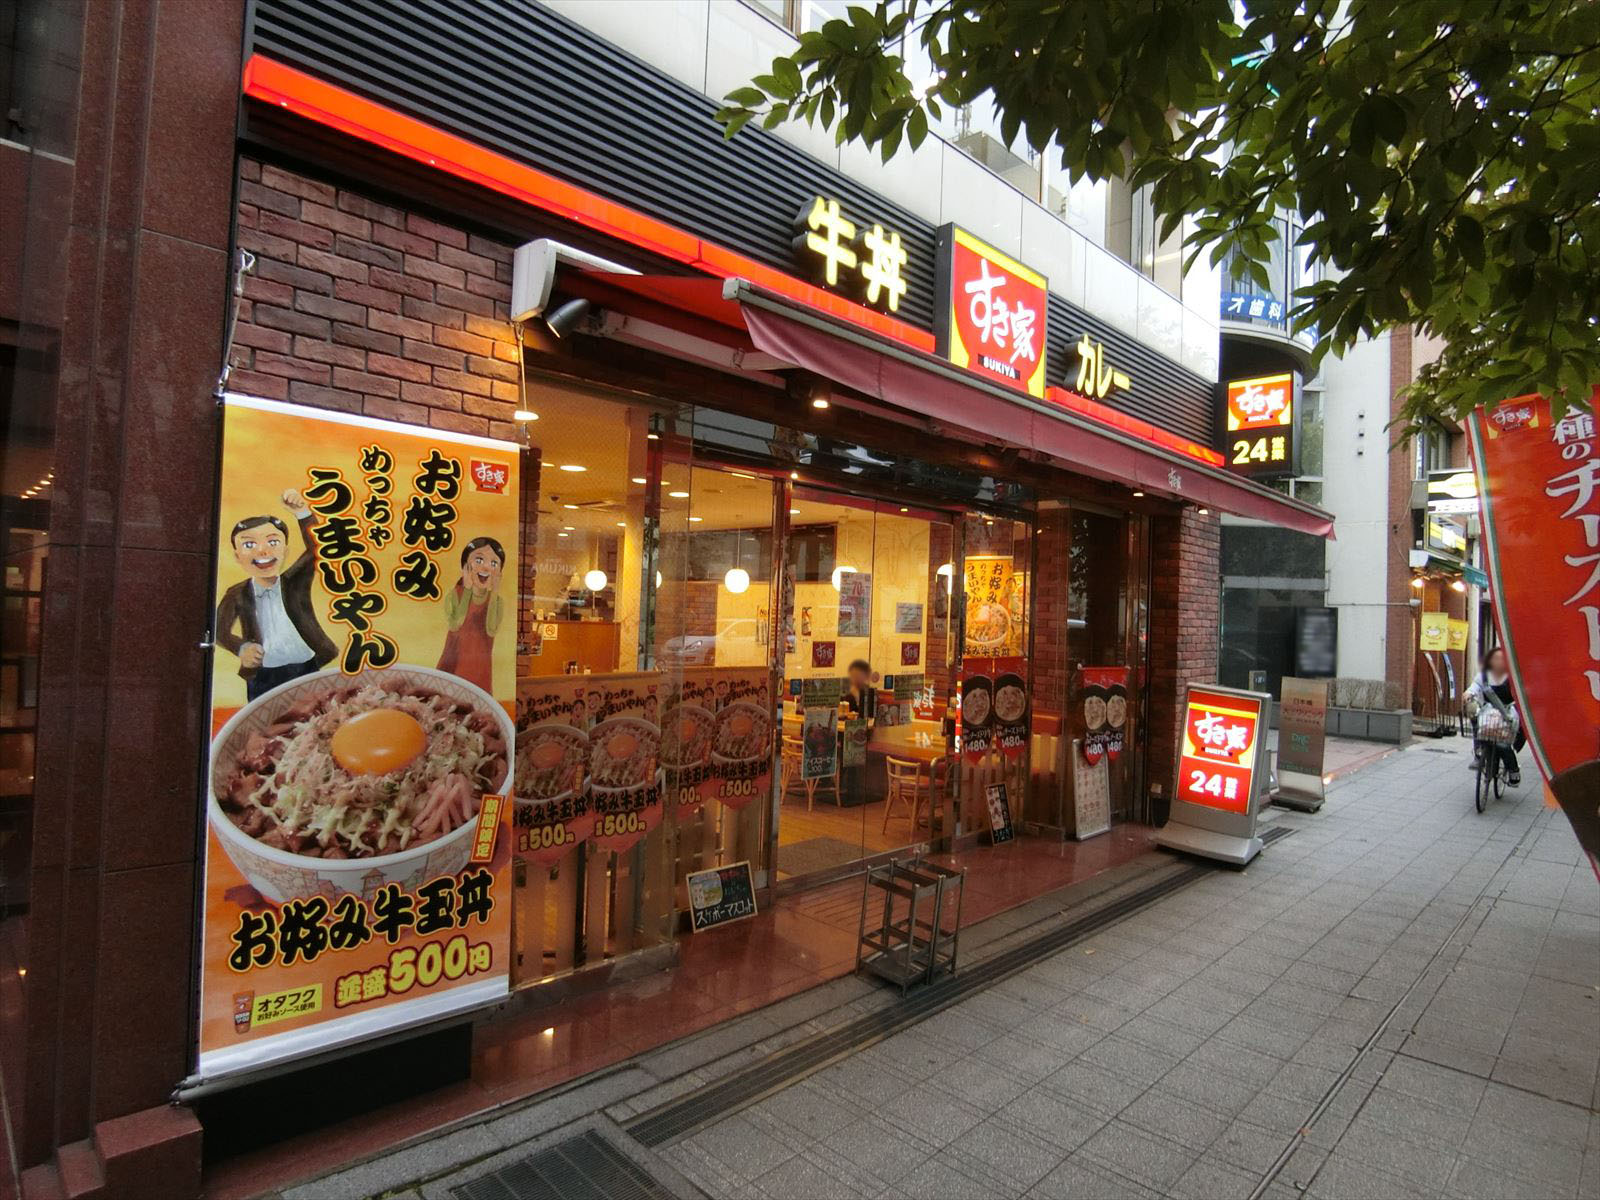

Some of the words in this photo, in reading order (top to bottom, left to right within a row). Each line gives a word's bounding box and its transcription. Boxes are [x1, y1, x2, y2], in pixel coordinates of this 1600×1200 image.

[807, 196, 908, 312] 牛丼
[965, 258, 1036, 364] すき家
[983, 356, 1016, 379] SUKIYA
[1077, 334, 1131, 399] カレー
[1236, 384, 1286, 416] すき家
[1491, 407, 1531, 425] すき家
[360, 446, 393, 549] めっちゃ
[475, 462, 505, 485] すき家
[395, 449, 462, 600] お好み
[304, 468, 398, 675] うまいやん
[1194, 711, 1248, 751] すき家
[229, 868, 494, 972] お好み牛玉丼
[258, 989, 316, 1012] オタフク
